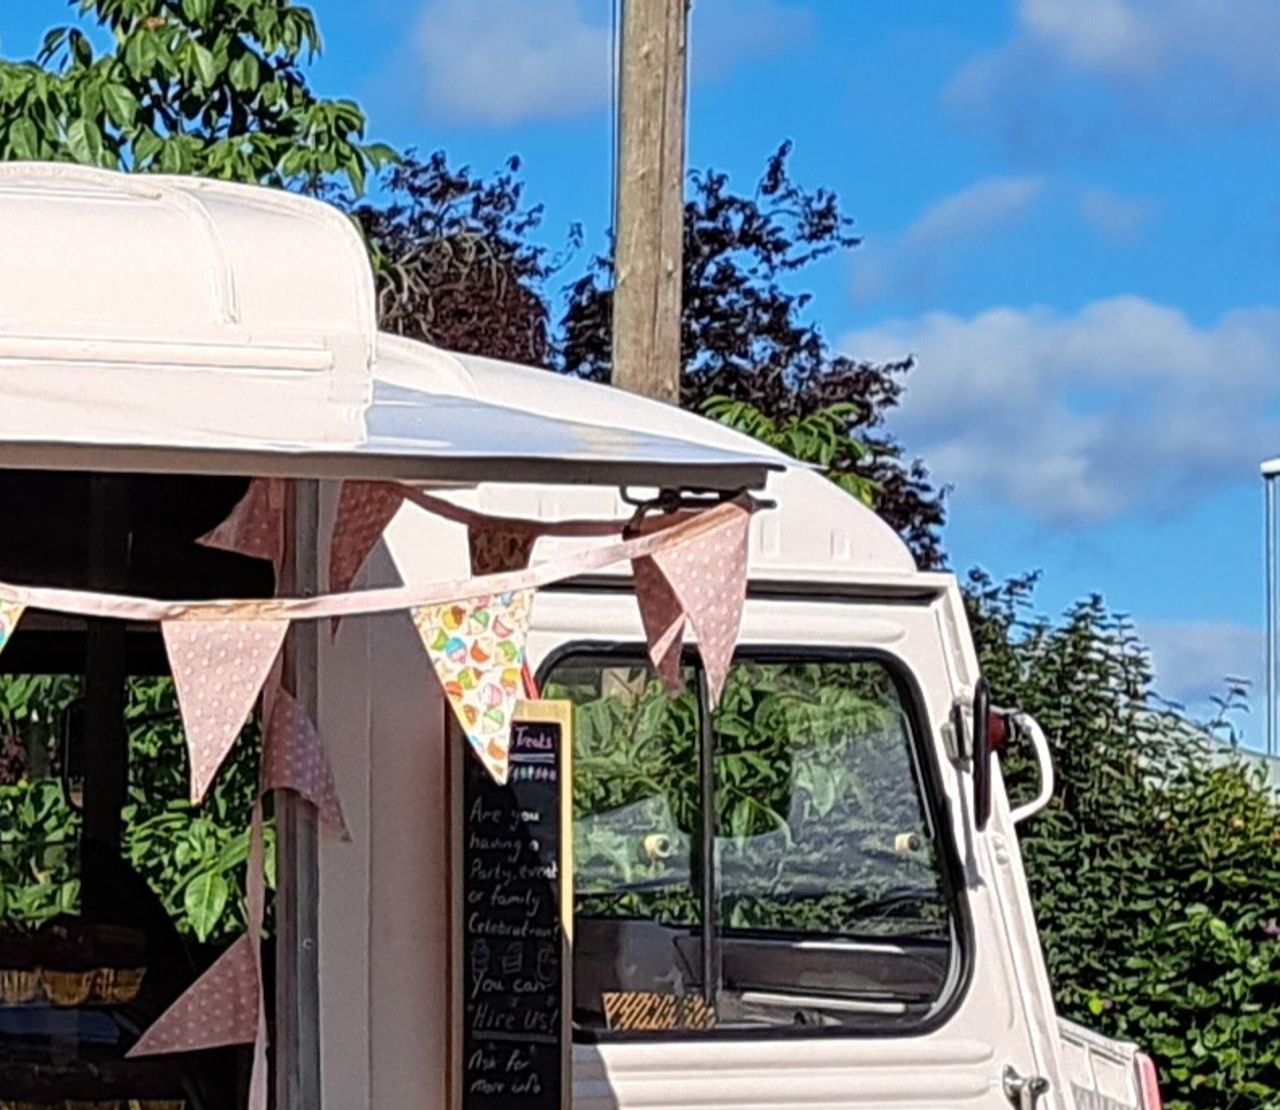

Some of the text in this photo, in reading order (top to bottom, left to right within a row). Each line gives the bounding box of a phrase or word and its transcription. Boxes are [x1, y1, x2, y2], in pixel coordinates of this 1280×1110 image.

[469, 799, 540, 831] Are you
[468, 836, 522, 863] having
[491, 884, 541, 917] family
[471, 970, 546, 999] You can
[473, 1002, 516, 1030] Hire
[505, 1048, 530, 1073] for
[470, 1078, 505, 1094] more
